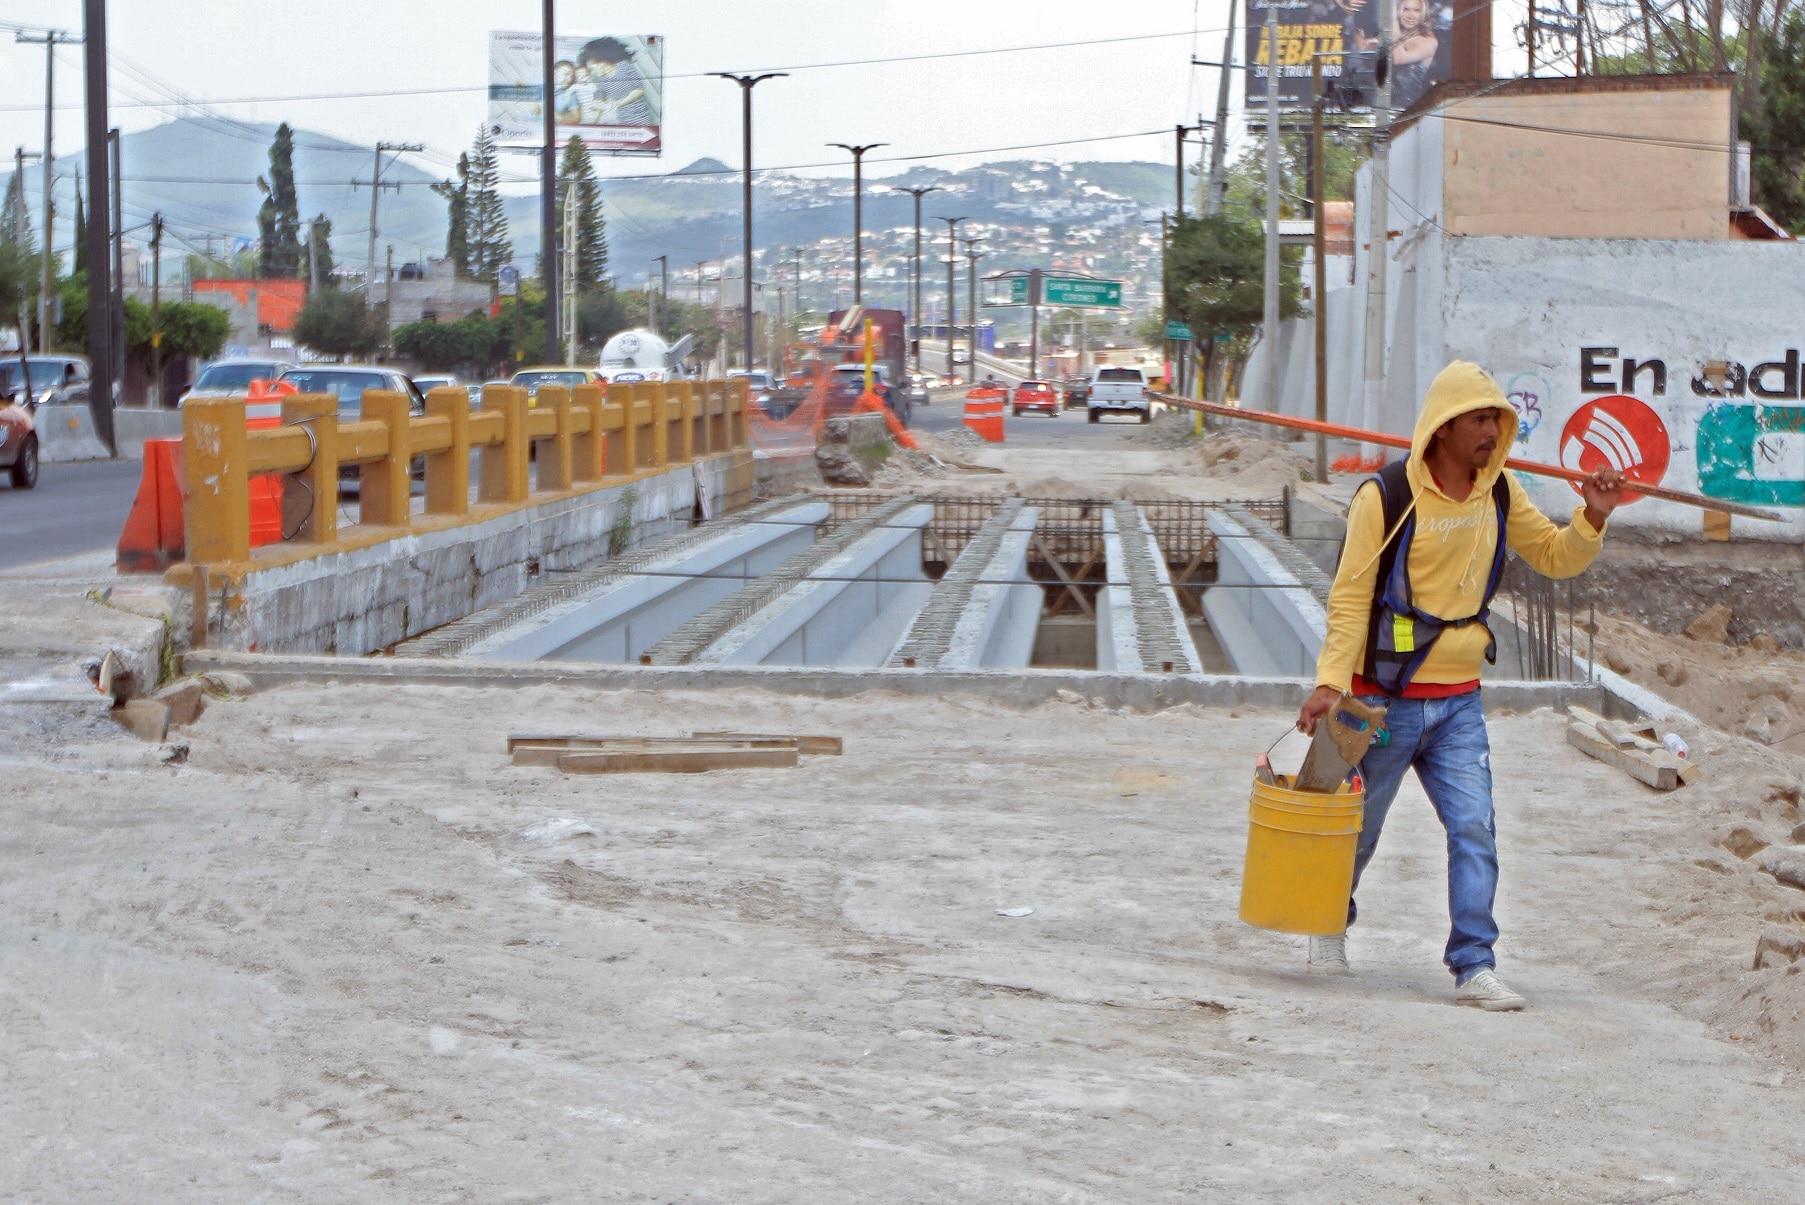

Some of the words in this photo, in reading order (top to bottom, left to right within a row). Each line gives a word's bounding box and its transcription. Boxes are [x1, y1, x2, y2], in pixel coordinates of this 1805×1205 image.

[1260, 24, 1304, 39] RBAJA
[1284, 66, 1342, 77] TRIUNNDO
[1581, 347, 1667, 396] En
